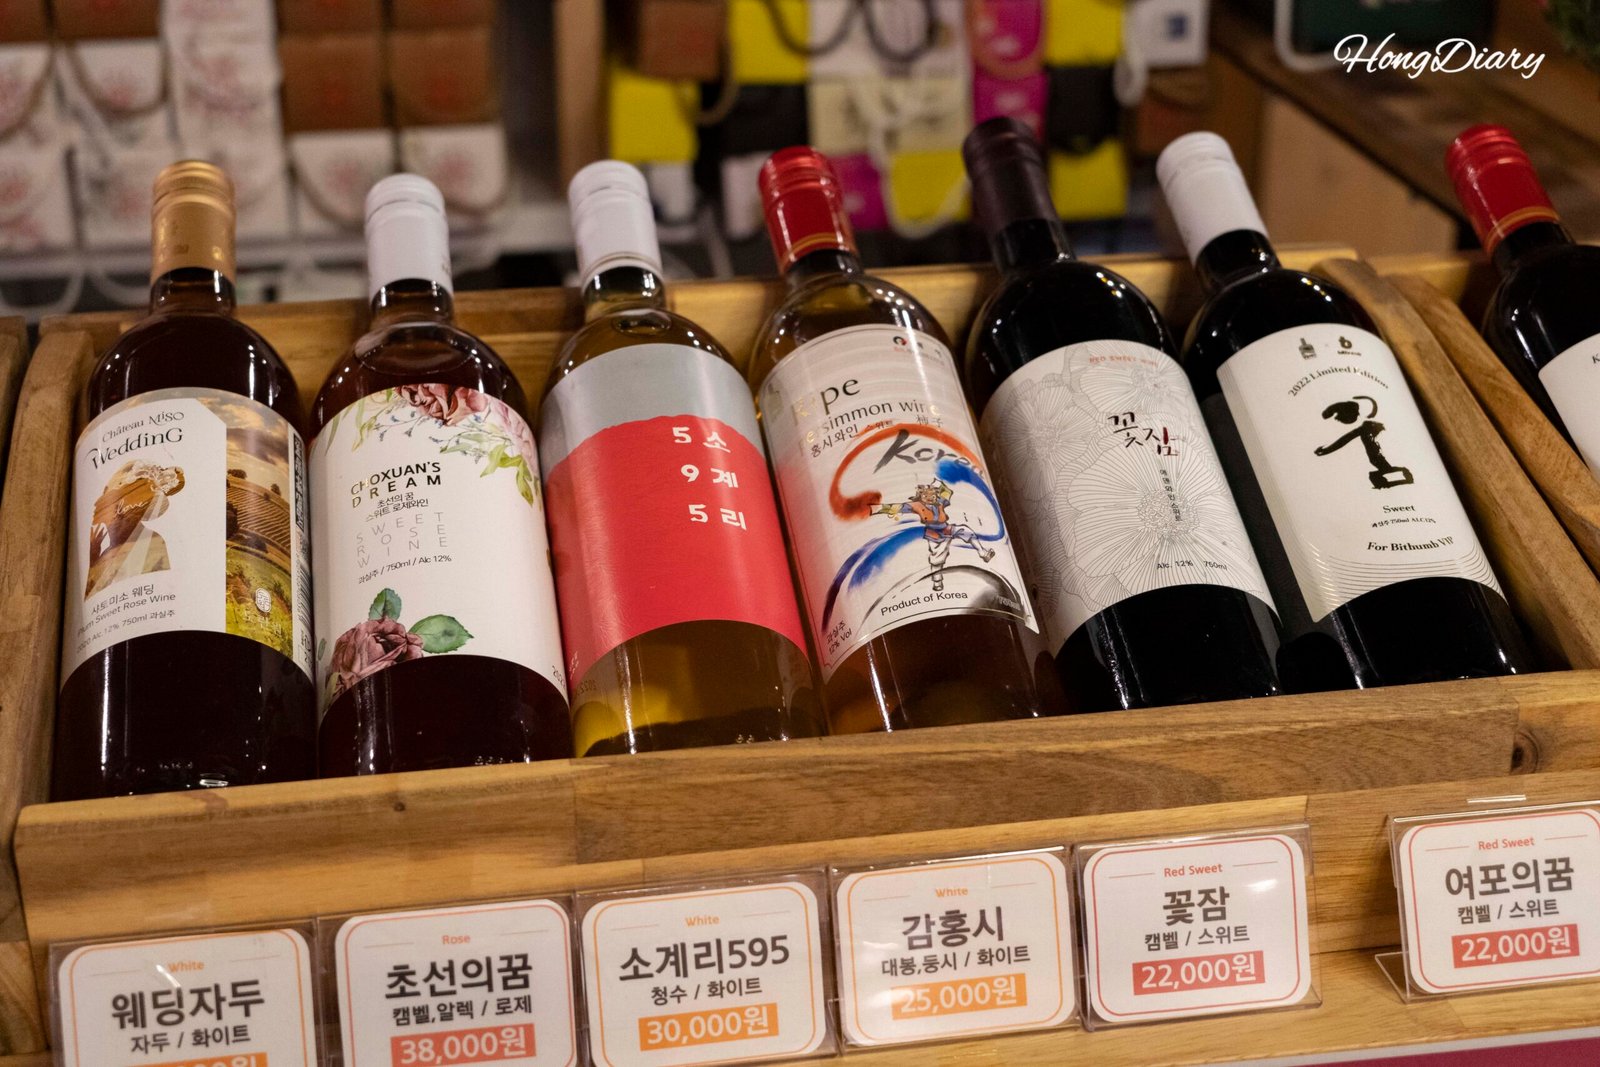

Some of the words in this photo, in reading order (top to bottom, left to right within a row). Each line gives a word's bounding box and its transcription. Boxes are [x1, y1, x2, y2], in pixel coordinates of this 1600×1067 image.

[1288, 376, 1311, 396] 2022
[1309, 366, 1351, 380] Limited
[790, 378, 861, 427] Rpe
[102, 420, 144, 442] Château
[811, 423, 859, 457] 홍시와인
[350, 461, 441, 496] CHOXUAN'S
[1382, 505, 1416, 514] Sweet
[1367, 541, 1388, 551] For
[1391, 540, 1439, 551] Bithumb
[1437, 535, 1454, 546] VIP
[386, 559, 411, 572] 750ml
[434, 555, 452, 563] 12%
[123, 597, 147, 611] Rose
[149, 593, 176, 604] Wine
[132, 584, 154, 598] 웨딩
[880, 597, 922, 617] Product
[923, 592, 934, 603] of
[936, 590, 969, 601] Korea
[122, 614, 147, 627] 750ml
[1478, 840, 1499, 850] Red
[1502, 837, 1535, 848] Sweet
[1164, 866, 1185, 877] Red
[1189, 863, 1223, 875] Sweet
[1445, 856, 1575, 901] 여포의꿈
[935, 886, 969, 898] White
[1162, 886, 1230, 926] 꽃잠
[685, 915, 720, 928] White
[1458, 903, 1491, 925] 캠벨
[1509, 898, 1560, 918] 스위트
[442, 934, 471, 945] Rose
[902, 905, 1004, 951] 감홍시
[1144, 930, 1179, 952] 캠벨
[1197, 925, 1250, 945] 스위트
[619, 934, 790, 982] 소계리595
[1460, 926, 1571, 963] 22,000원
[167, 960, 205, 973] White
[385, 953, 533, 999] 초선의꿈
[881, 951, 957, 977] 대봉,둥시
[977, 945, 1031, 967] 화이트
[1141, 953, 1257, 990] 22,000원
[111, 979, 265, 1030] 웨딩자두
[651, 984, 687, 1006] 청수
[707, 977, 763, 999] 화이트
[901, 975, 1018, 1014] 25,000원
[392, 1000, 474, 1027] 캠벨,알렉
[495, 995, 532, 1016] 로제
[647, 1006, 769, 1045] 30,000원
[131, 1032, 170, 1055] 자두
[192, 1024, 251, 1048] 화이트
[400, 1026, 527, 1065] 38,000원
